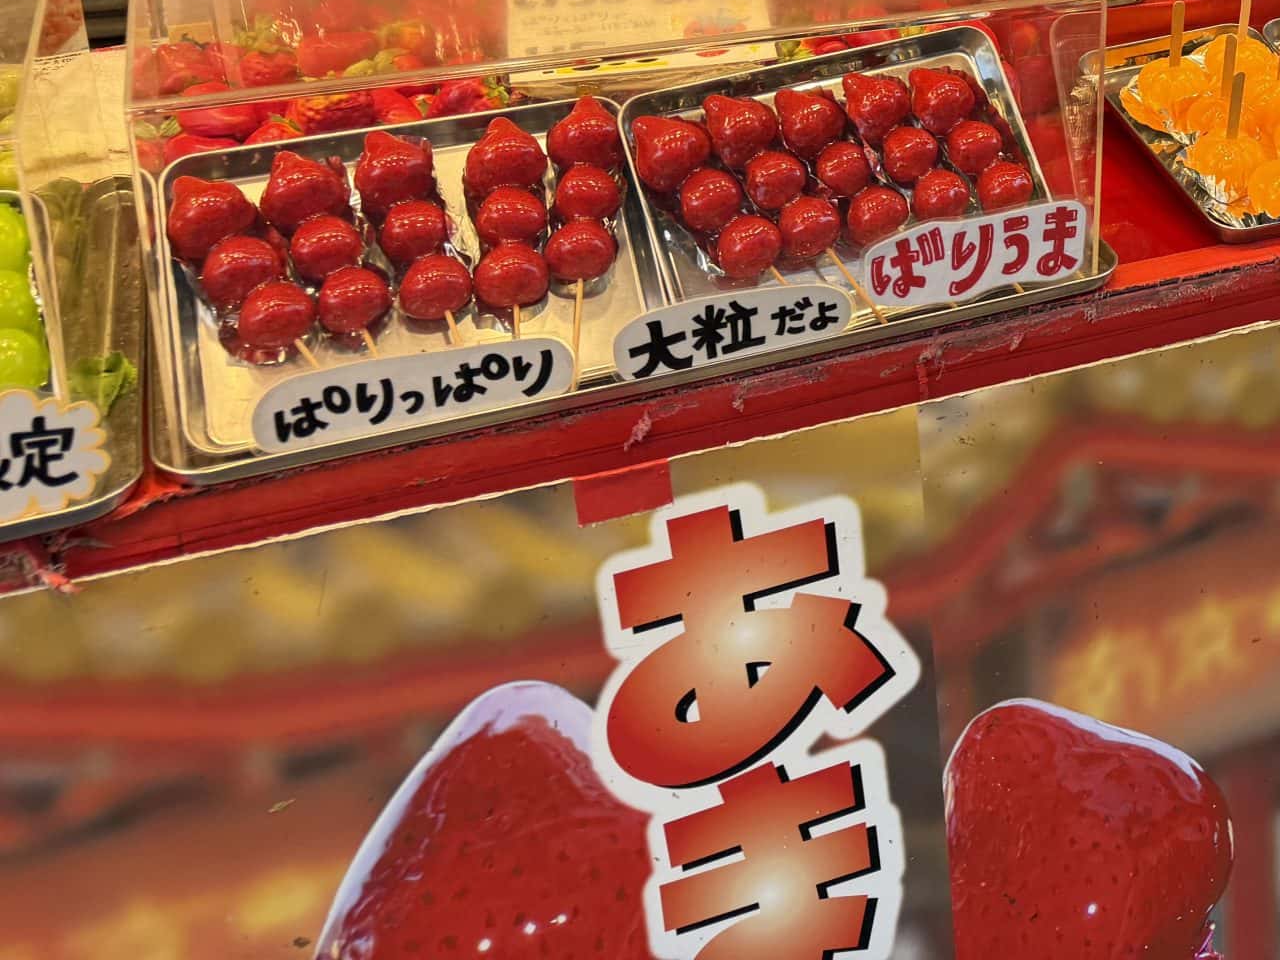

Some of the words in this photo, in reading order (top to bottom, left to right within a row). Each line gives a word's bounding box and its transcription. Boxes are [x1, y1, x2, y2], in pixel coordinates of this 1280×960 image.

[870, 207, 1081, 300] ばりうま
[627, 297, 844, 380] 大粒だよ
[273, 348, 555, 441] ぱりっぱり
[0, 415, 79, 492] 定
